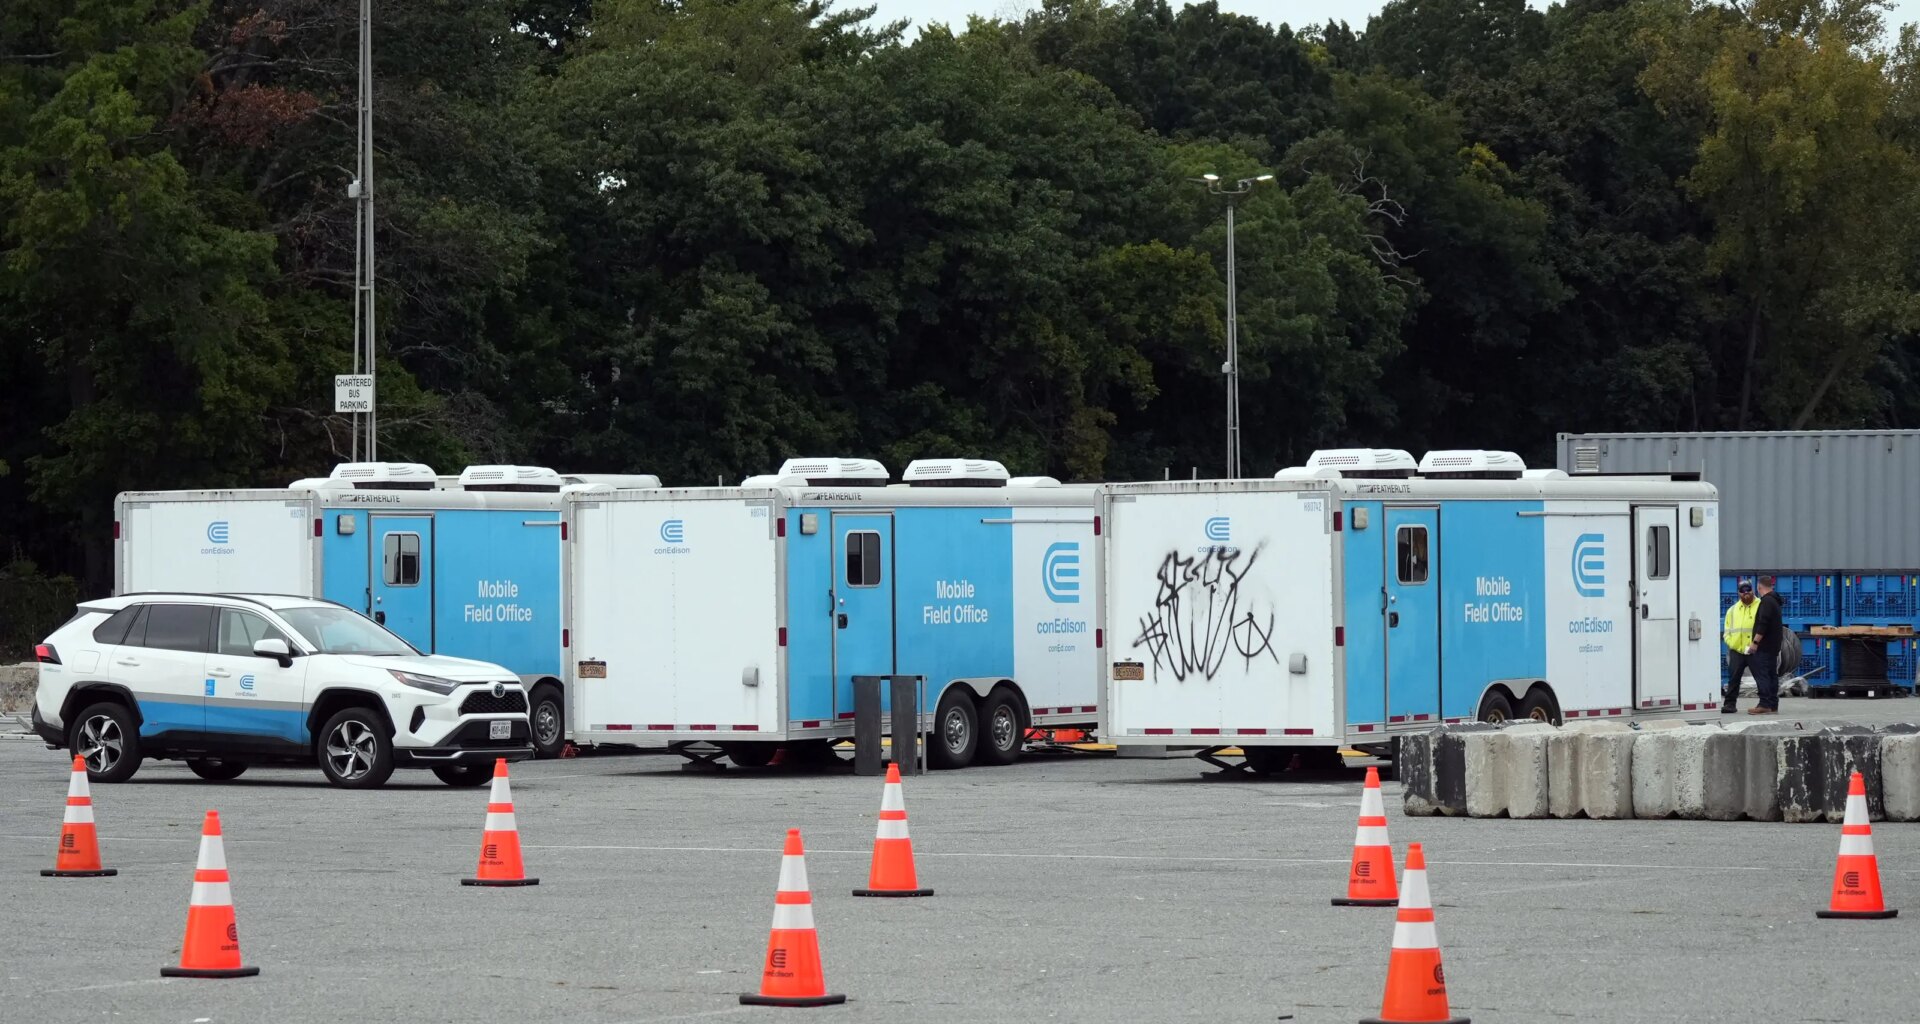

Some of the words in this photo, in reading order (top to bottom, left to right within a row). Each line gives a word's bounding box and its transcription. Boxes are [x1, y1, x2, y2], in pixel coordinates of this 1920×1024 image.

[336, 378, 372, 387] CHARTERED
[348, 389, 360, 398] BUS
[340, 400, 368, 410] PARKING
[1373, 484, 1411, 493] FEATHERLITE
[356, 494, 401, 503] FEATHERLITE
[820, 492, 862, 501] FEATHERLITE
[200, 547, 235, 555] conEdison
[654, 546, 690, 555] conEdison
[478, 579, 519, 598] Mobile
[936, 579, 975, 599] Mobile
[1476, 576, 1511, 596] Mobile
[464, 604, 493, 622] Field
[496, 603, 532, 622] Office
[923, 605, 951, 625] Field
[953, 604, 988, 623] Office
[1464, 603, 1489, 623] Field
[1491, 602, 1523, 622] Office
[1036, 617, 1087, 634] conEdison
[1568, 616, 1613, 634] conEdison
[1047, 644, 1076, 652] conEd.com
